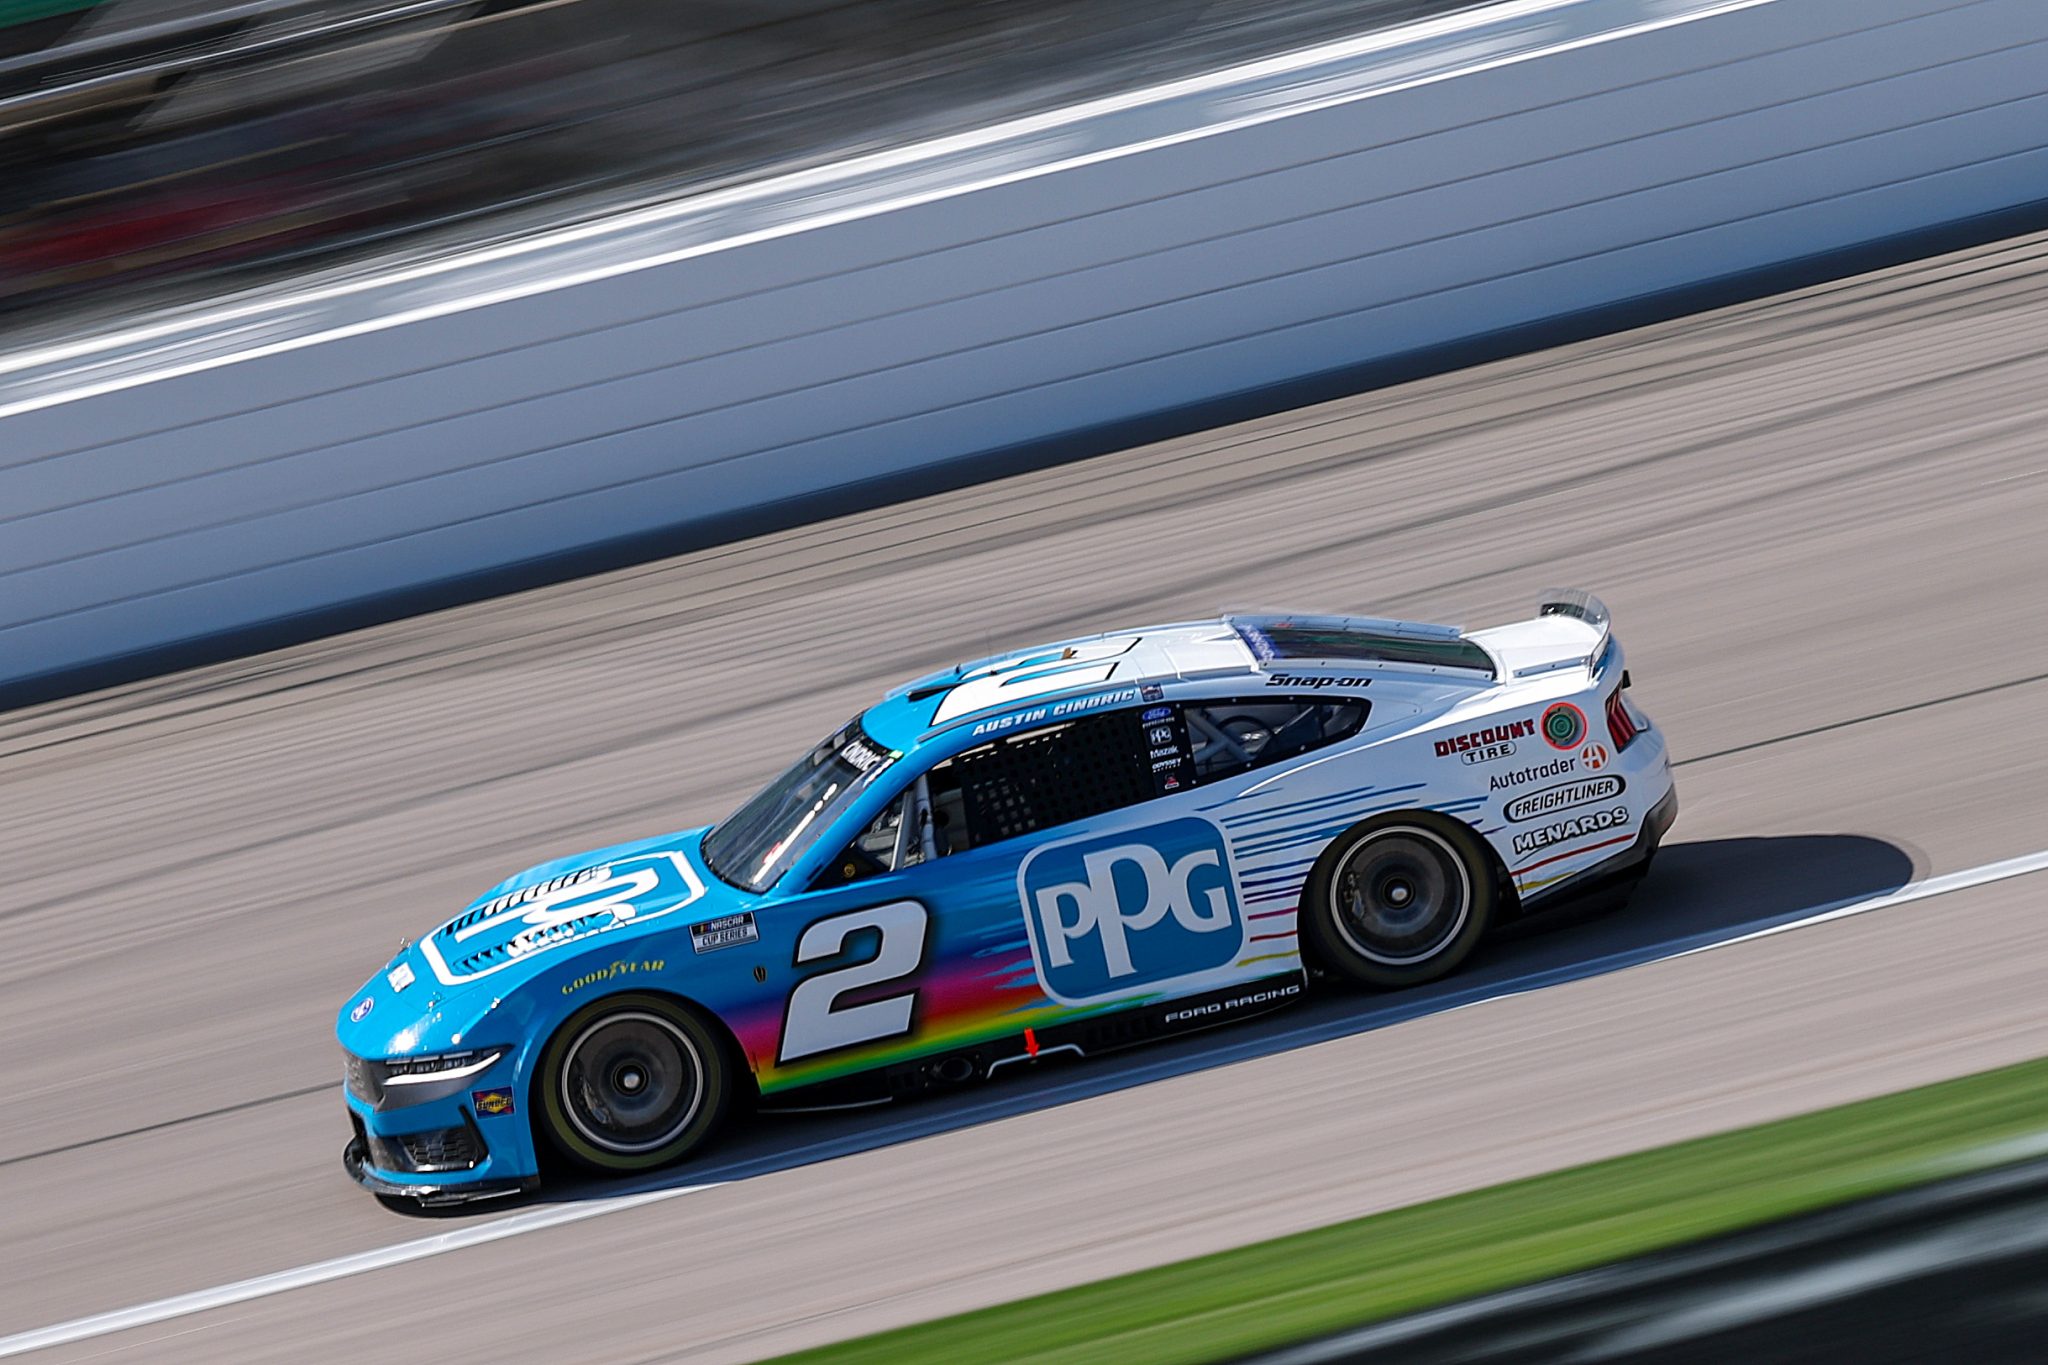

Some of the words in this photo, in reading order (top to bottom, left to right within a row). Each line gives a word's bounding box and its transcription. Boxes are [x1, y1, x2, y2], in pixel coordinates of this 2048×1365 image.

[1265, 673, 1373, 689] Snap-on
[972, 708, 1047, 737] AUSTIN
[1052, 689, 1136, 716] CINDRIC
[1150, 745, 1179, 759] Mazak
[1434, 718, 1535, 757] DISCOUNT
[1465, 743, 1513, 765] TIRE
[1489, 757, 1576, 792] Autotrader
[1514, 779, 1615, 818] FREIGHTLINER
[1512, 807, 1630, 855] MENARDS
[711, 914, 744, 932] NASCAR
[1035, 843, 1234, 979] PPG
[702, 932, 719, 946] CUP
[719, 926, 748, 942] SERIES
[561, 959, 665, 995] GOODYEAR
[777, 899, 928, 1065] 2
[1165, 1002, 1222, 1024] FORD
[1225, 984, 1300, 1008] RACING
